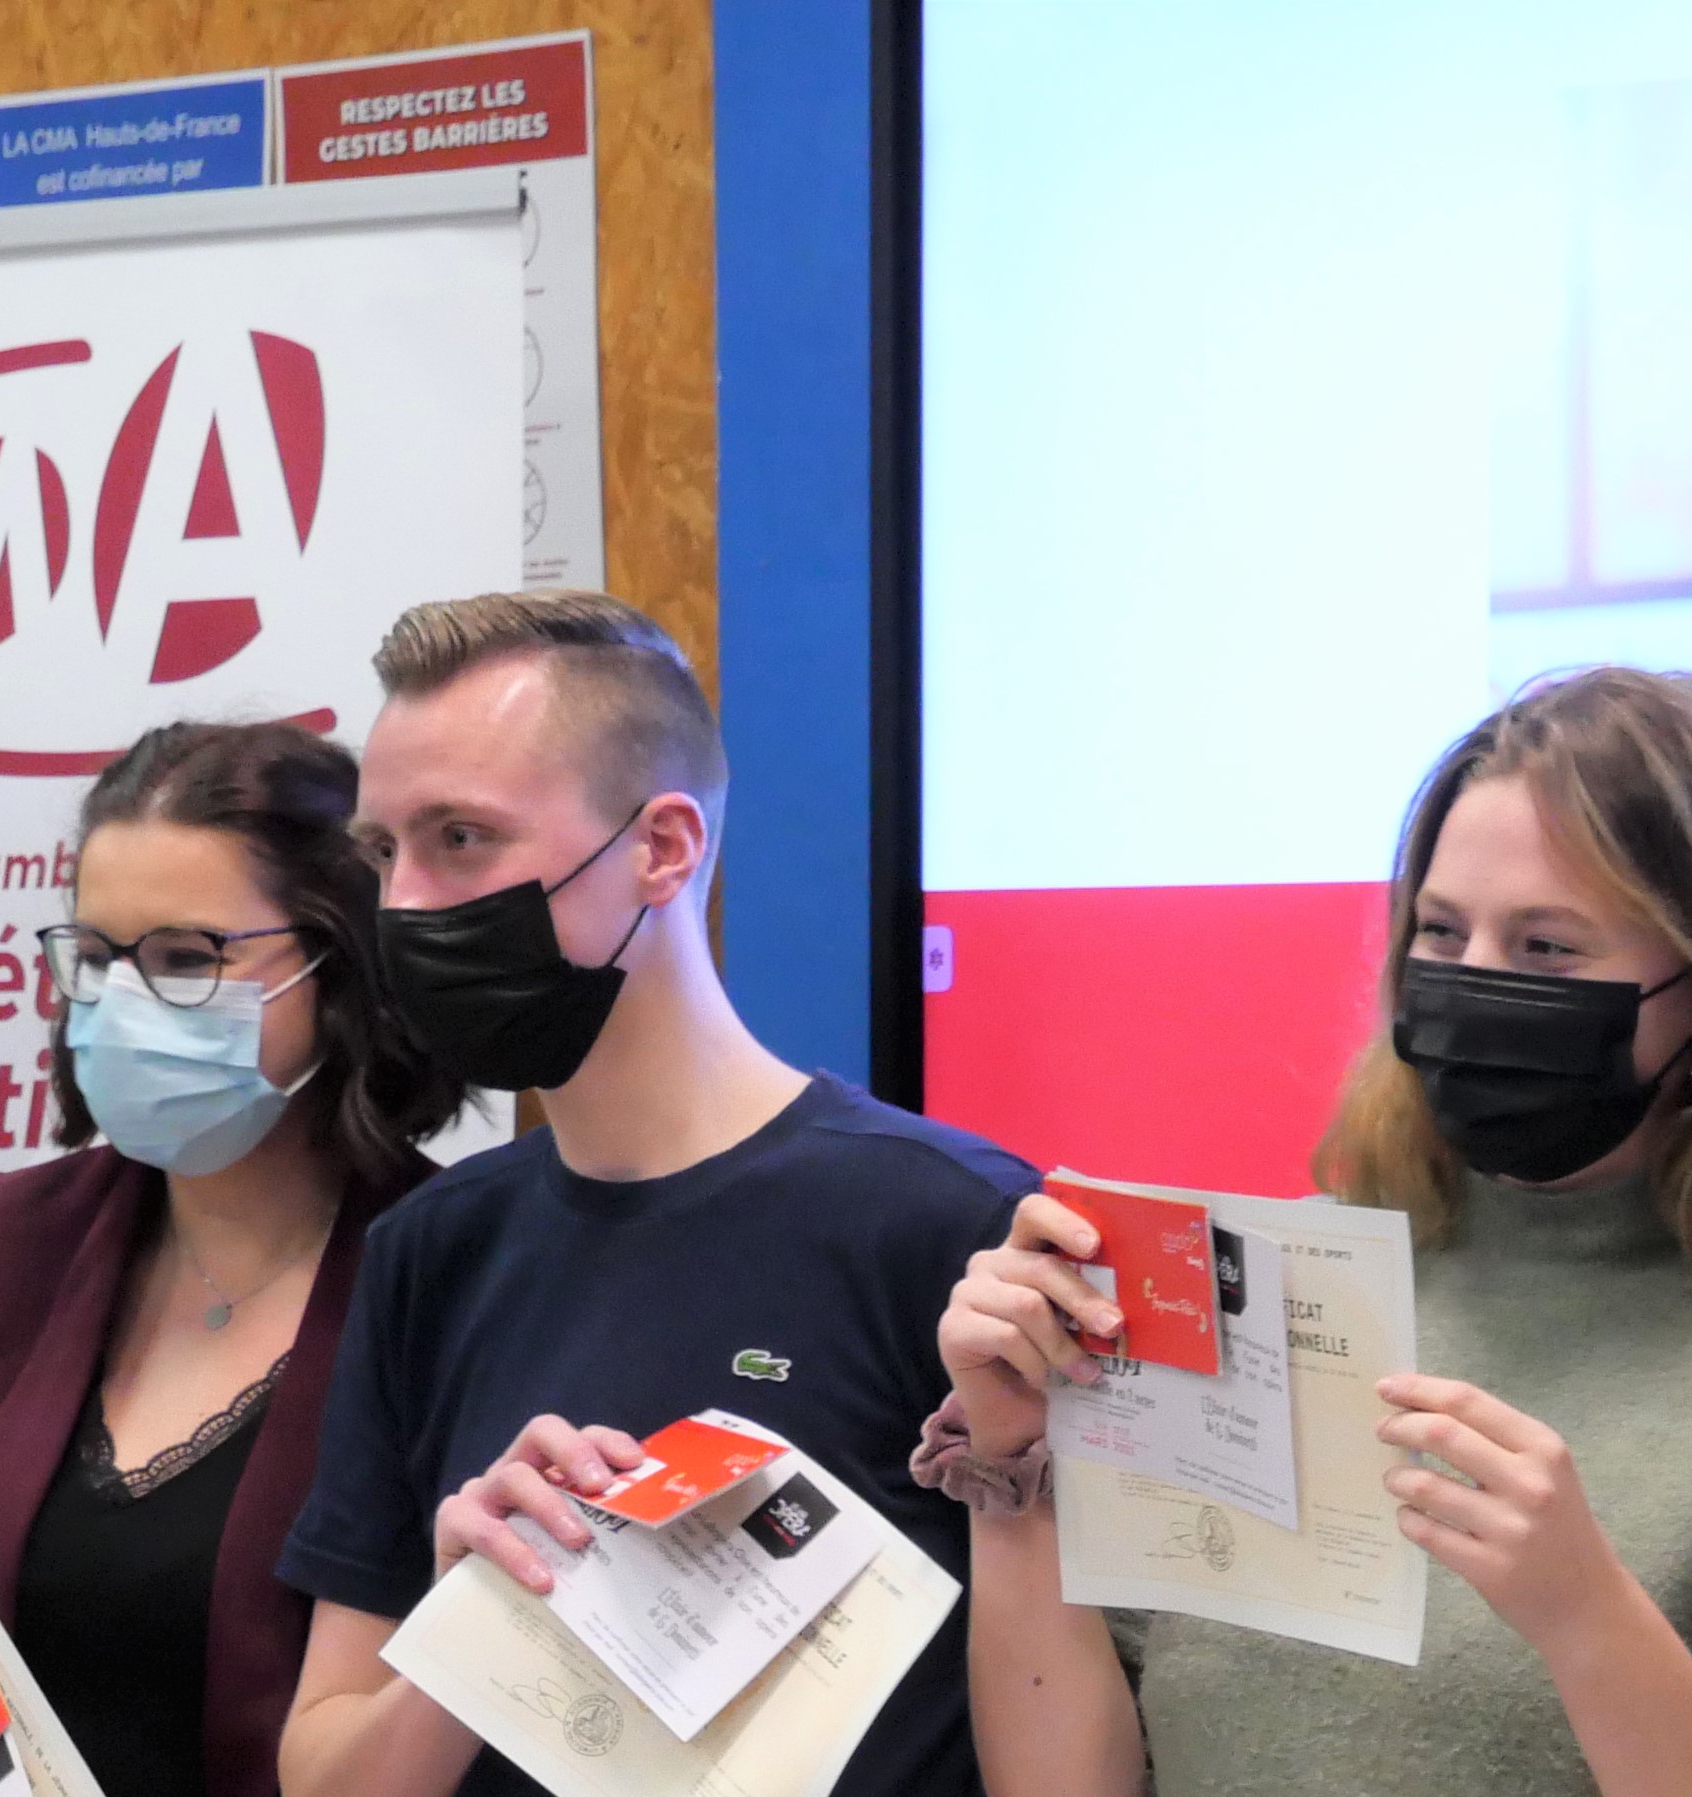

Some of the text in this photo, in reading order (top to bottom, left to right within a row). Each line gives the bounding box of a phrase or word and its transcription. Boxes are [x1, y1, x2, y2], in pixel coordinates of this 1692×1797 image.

[340, 79, 526, 125] RESPECTEZ LES
[2, 131, 29, 158] LA
[30, 125, 78, 155] CMA
[319, 111, 549, 163] GESTES BARRIÈRES
